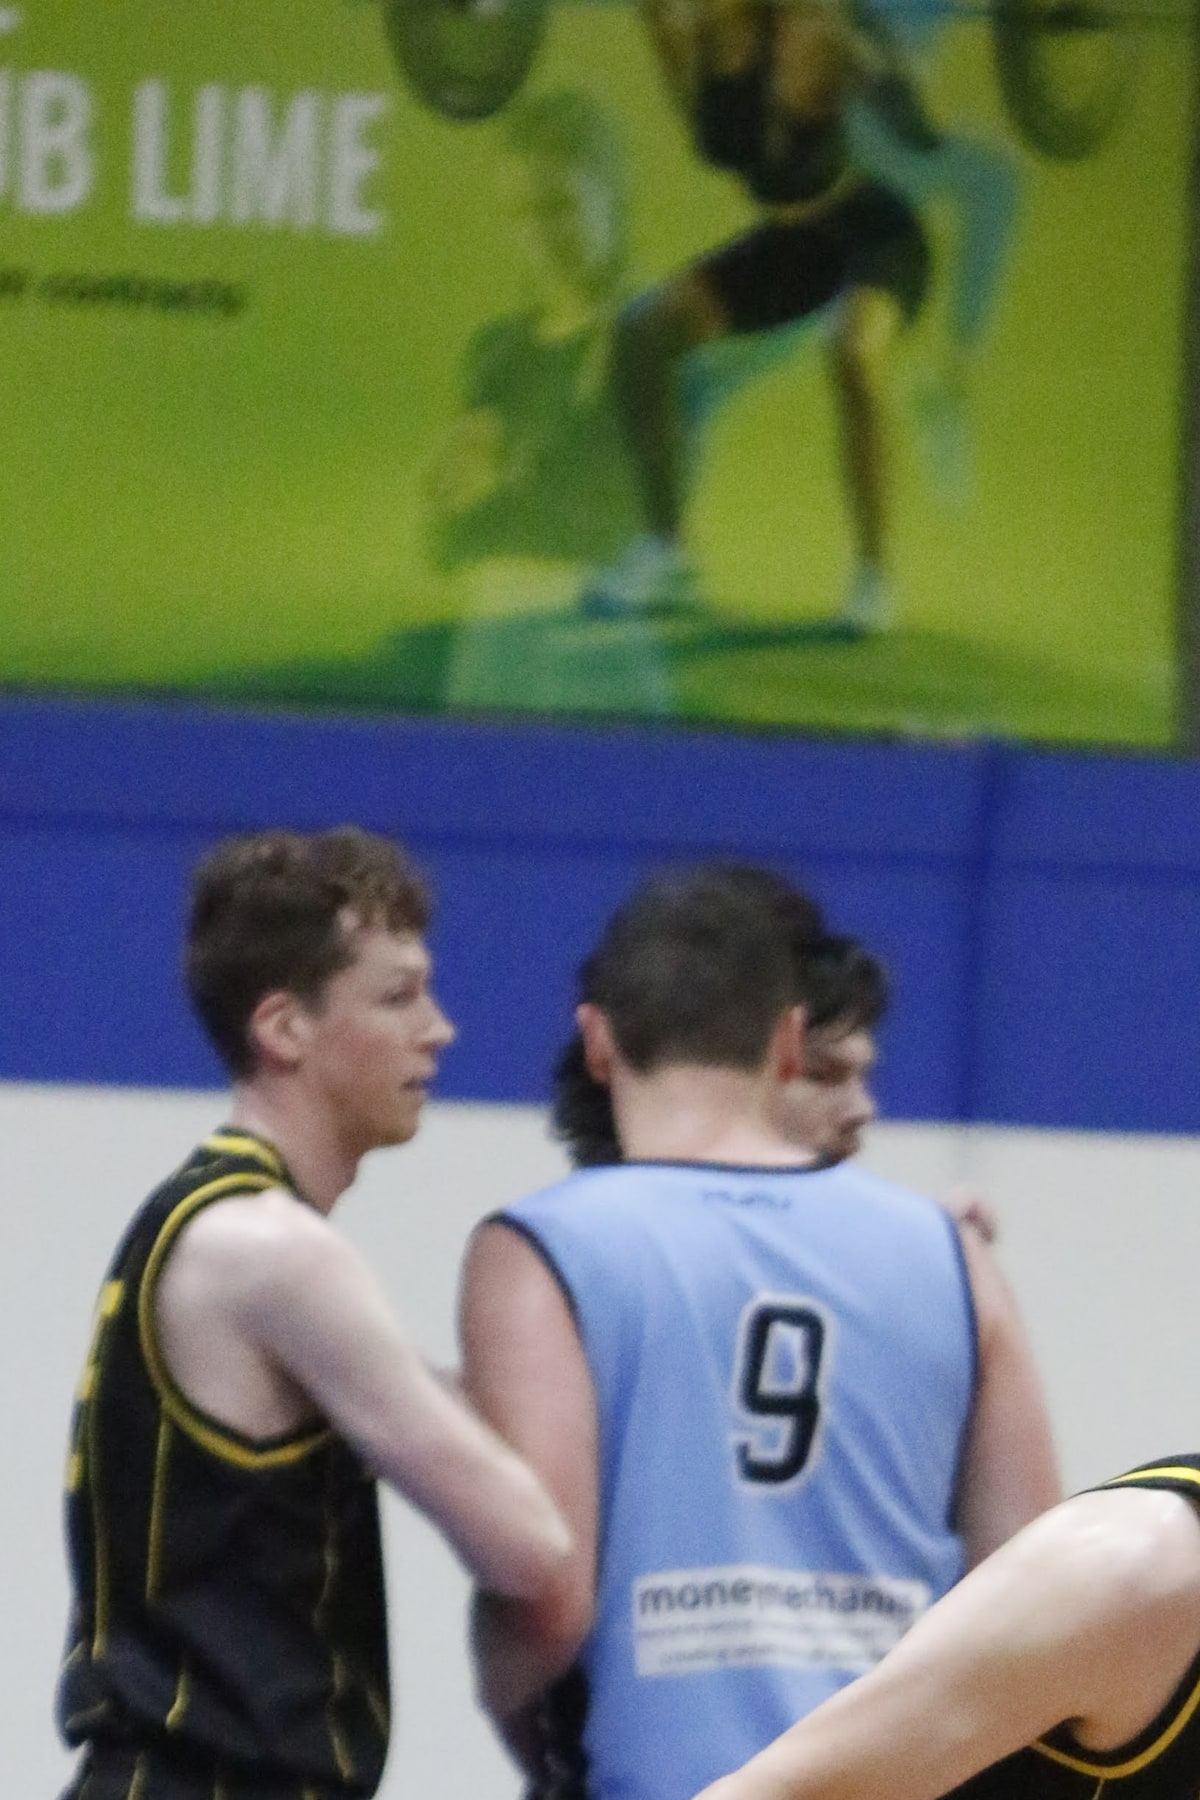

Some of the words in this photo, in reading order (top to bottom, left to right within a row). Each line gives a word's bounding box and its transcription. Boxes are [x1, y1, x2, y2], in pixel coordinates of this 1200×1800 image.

[0, 67, 94, 214] B
[132, 76, 388, 237] LIME
[734, 1300, 832, 1490] 9
